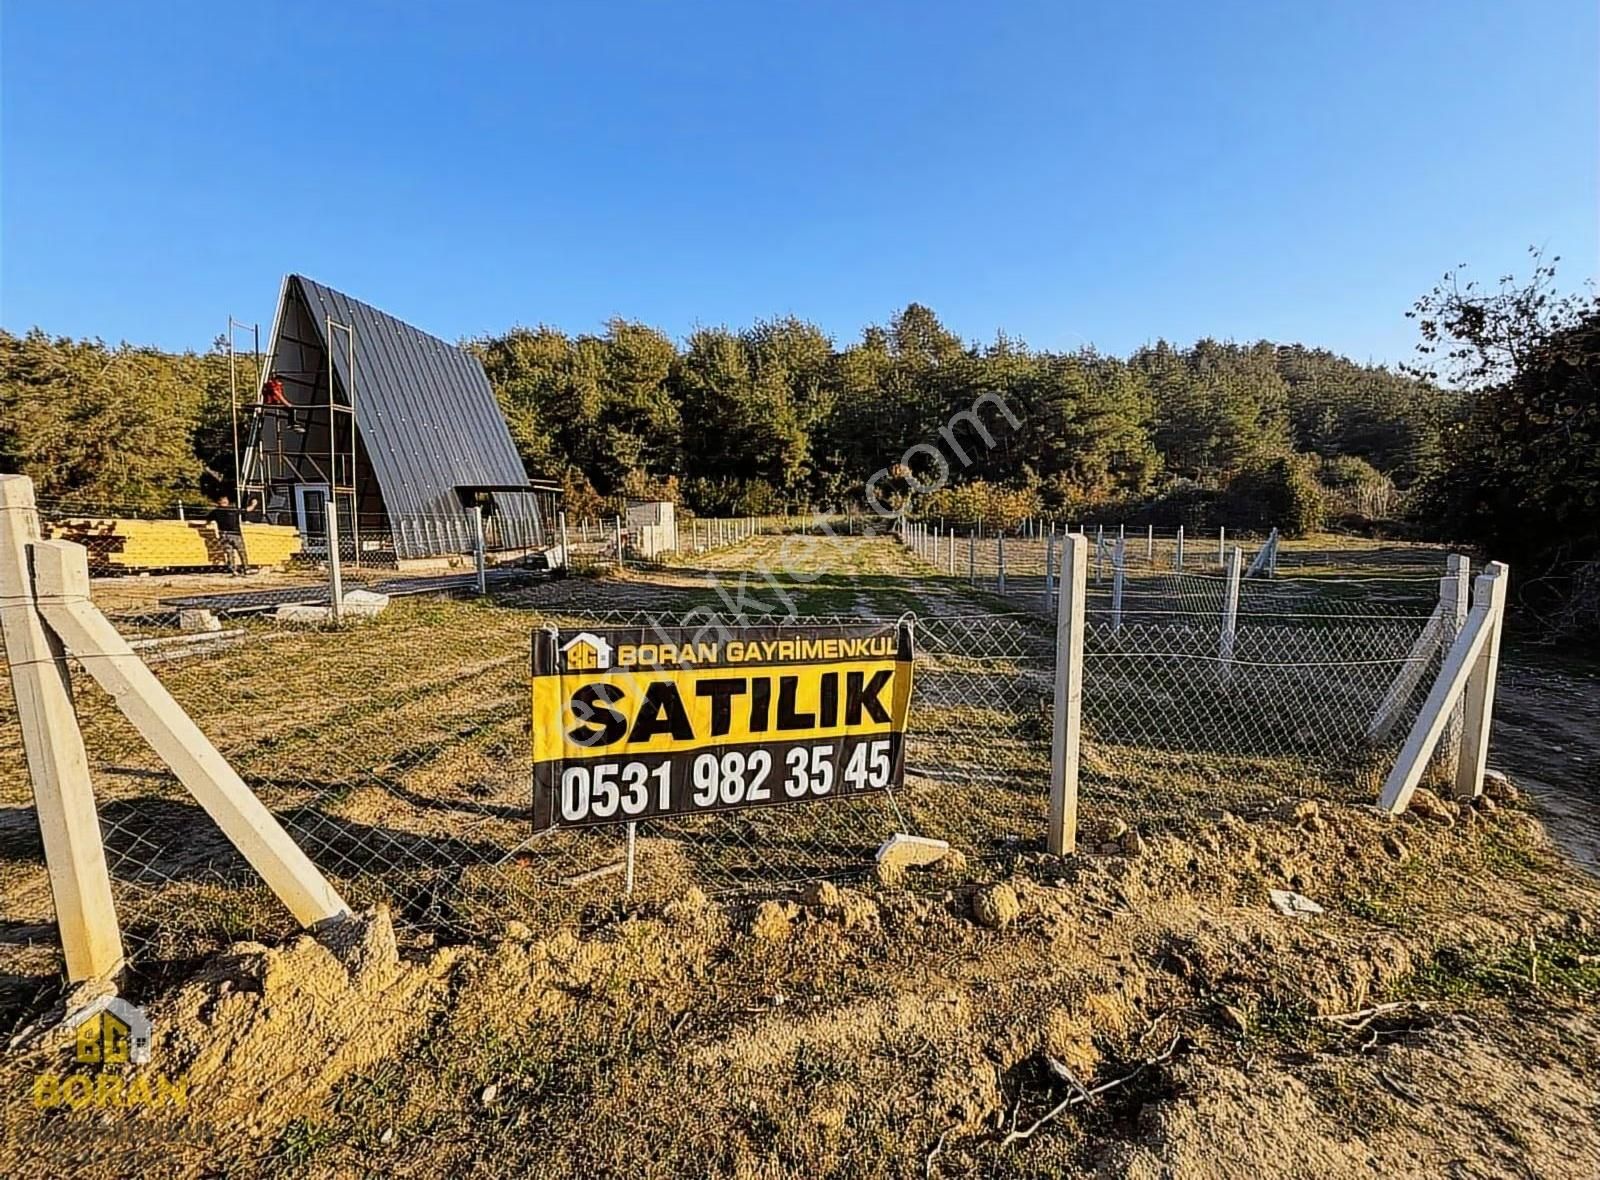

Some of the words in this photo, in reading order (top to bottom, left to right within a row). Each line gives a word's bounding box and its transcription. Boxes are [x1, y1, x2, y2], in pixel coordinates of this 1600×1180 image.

[618, 640, 717, 666] BORAN
[726, 635, 898, 663] GAYRİMENKUL
[568, 669, 895, 747] SATILIK
[561, 760, 671, 821] 0531
[693, 749, 771, 807] 982
[784, 745, 834, 798] 35
[844, 740, 891, 789] 45
